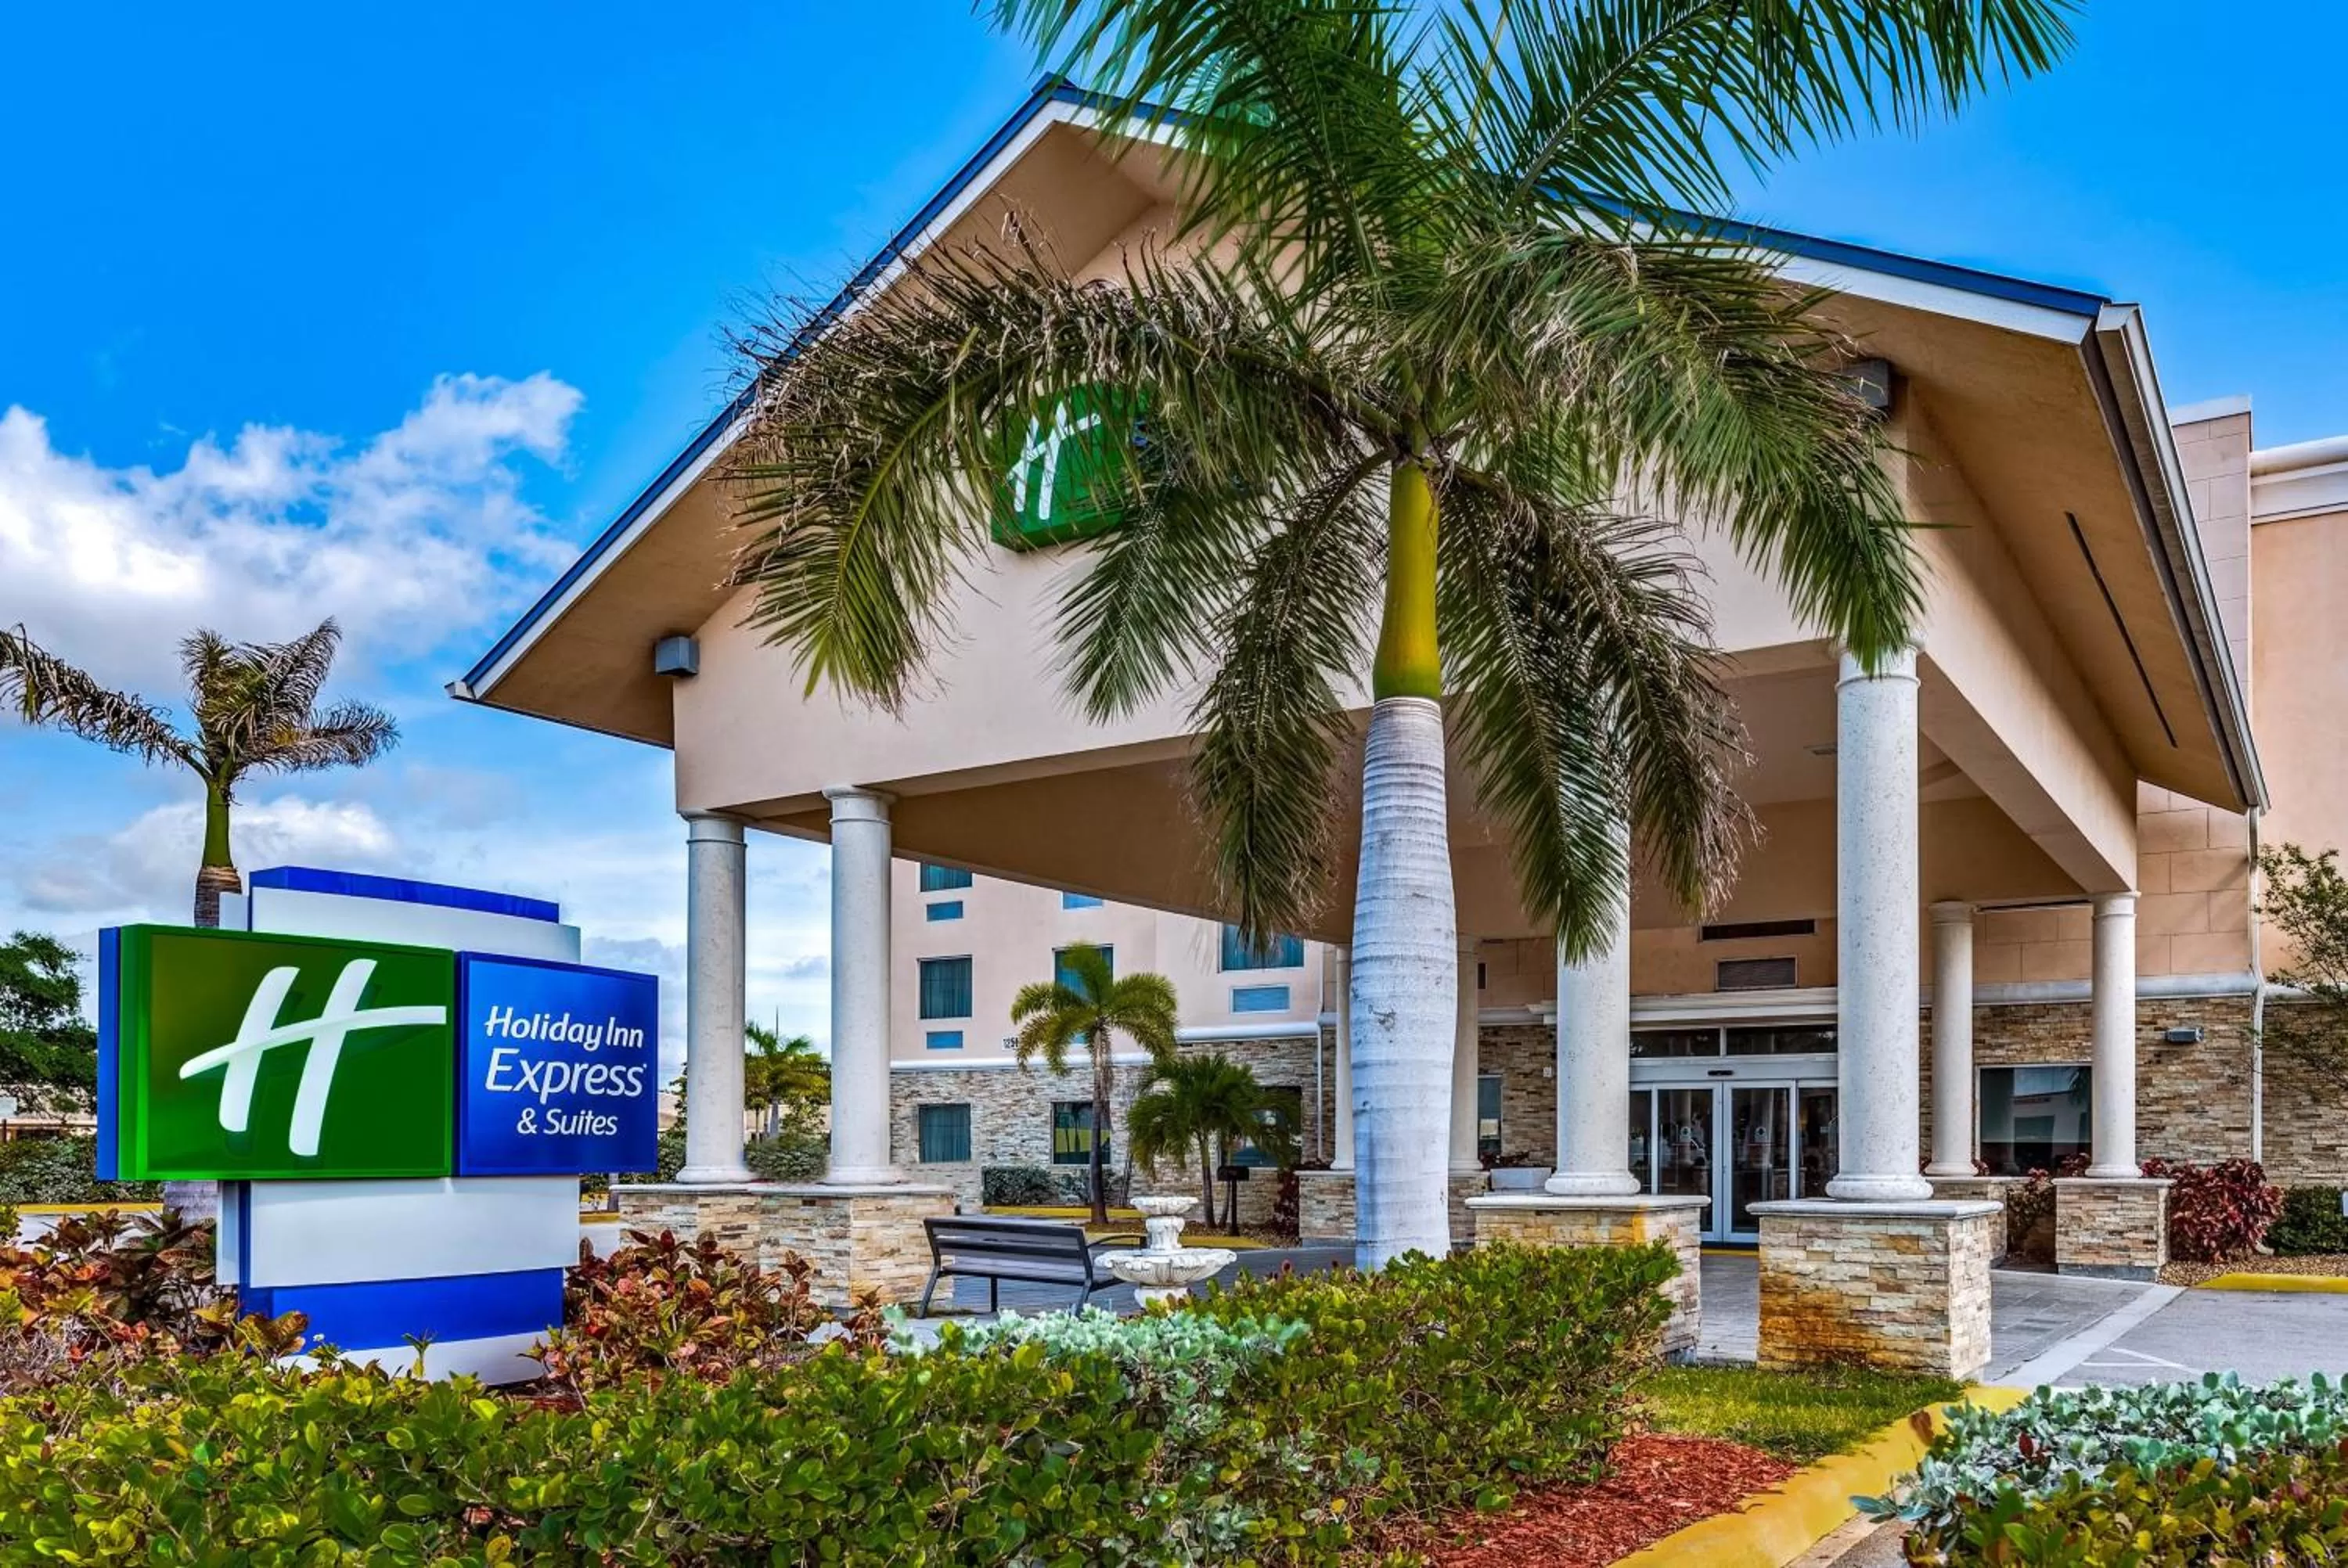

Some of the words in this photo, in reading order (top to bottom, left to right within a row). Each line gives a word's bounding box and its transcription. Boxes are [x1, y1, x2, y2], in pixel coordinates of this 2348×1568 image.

[1007, 400, 1101, 520] H
[179, 958, 446, 1156] H
[484, 1005, 603, 1052] Holiday
[605, 1016, 643, 1048] Inn
[485, 1048, 646, 1105] Express
[517, 1107, 538, 1134] &
[543, 1108, 618, 1135] Suites
